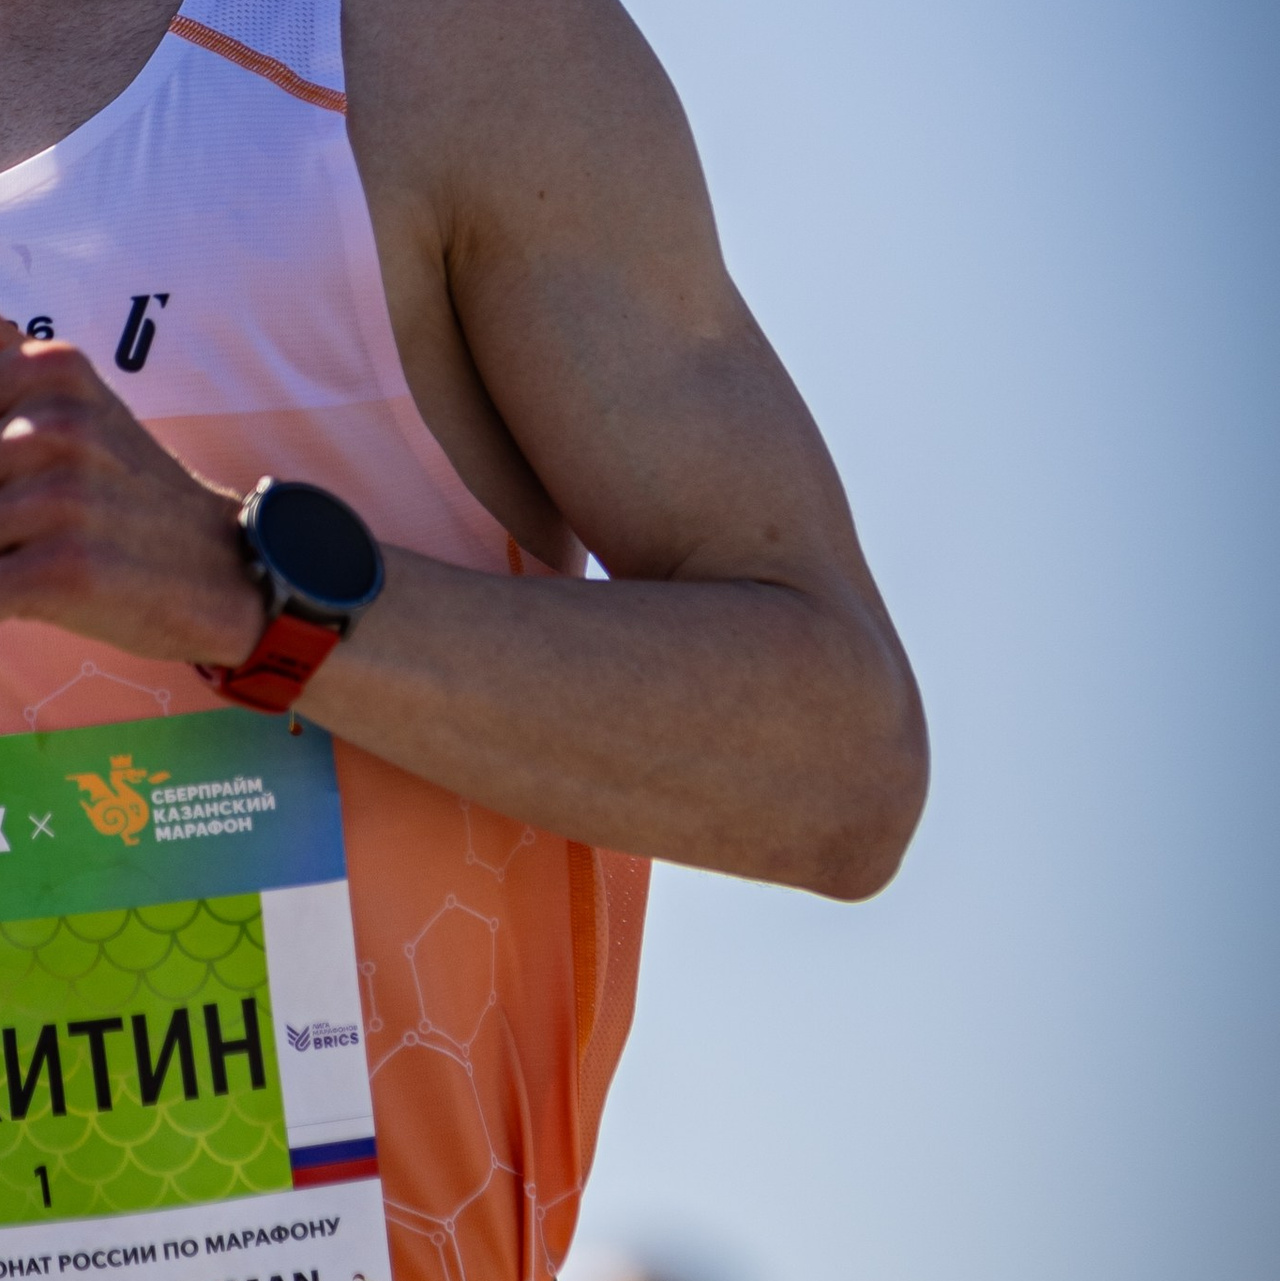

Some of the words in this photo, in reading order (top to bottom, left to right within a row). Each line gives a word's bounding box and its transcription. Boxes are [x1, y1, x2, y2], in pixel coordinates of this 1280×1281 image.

[151, 776, 263, 804] СБЕРПРАЙМ
[153, 792, 276, 823] КАЗАНСКИЙ
[155, 817, 253, 842] МАРАФОН
[313, 1032, 360, 1050] BRICS
[34, 1165, 52, 1209] 1
[58, 1245, 158, 1273] РОССИИ
[163, 1238, 200, 1261] ПО
[204, 1217, 341, 1255] МАРАФОНУ
